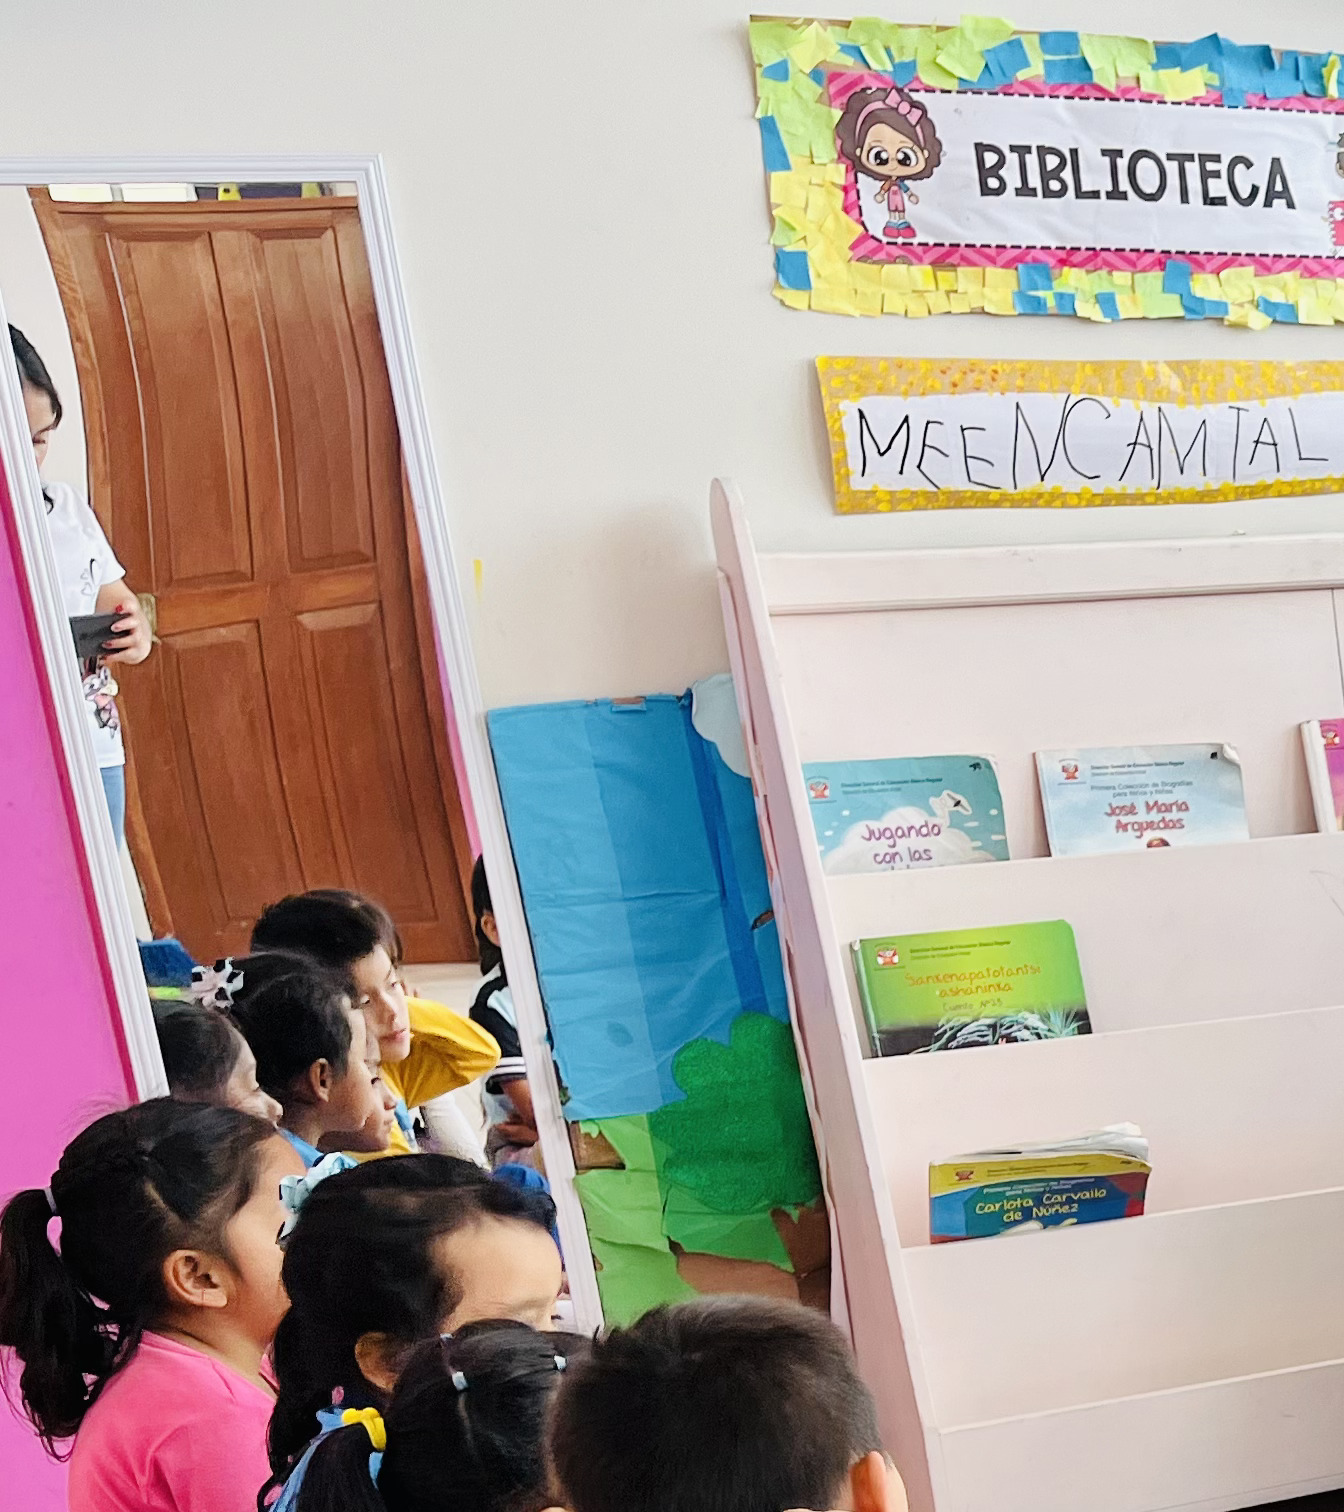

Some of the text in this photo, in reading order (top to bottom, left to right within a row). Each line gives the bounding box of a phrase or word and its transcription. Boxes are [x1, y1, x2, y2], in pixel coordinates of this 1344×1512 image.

[973, 141, 1297, 210] BIBLIOTECA
[1105, 798, 1190, 817] José María
[861, 821, 942, 848] Jugando
[1115, 816, 1186, 838] Arguedas
[873, 846, 933, 864] con las
[976, 1197, 1034, 1214] Carlota
[1003, 1203, 1079, 1222] de Núñez
